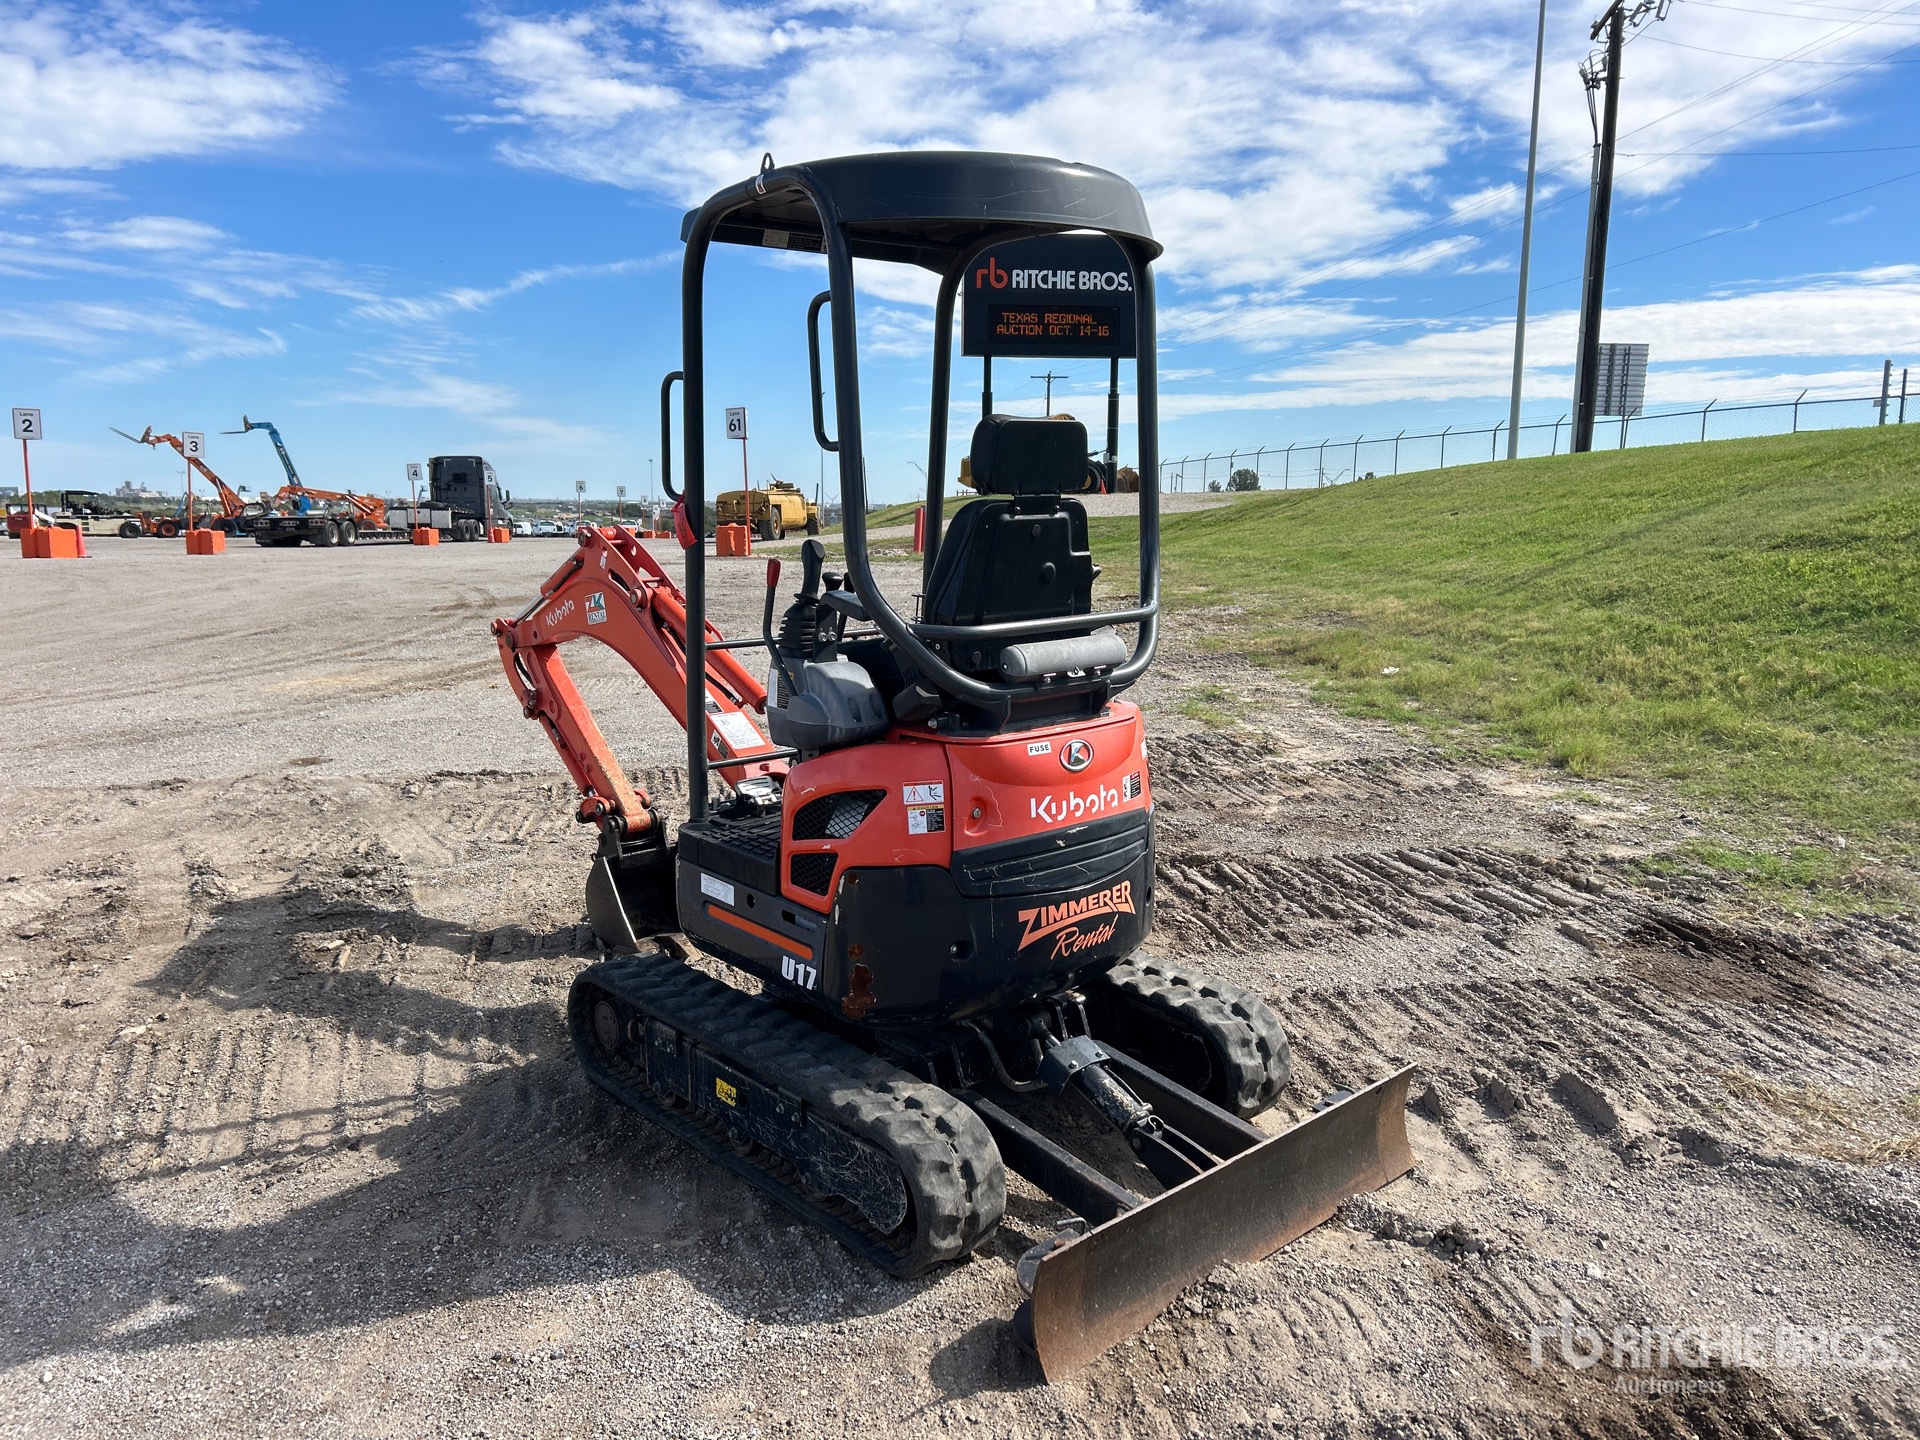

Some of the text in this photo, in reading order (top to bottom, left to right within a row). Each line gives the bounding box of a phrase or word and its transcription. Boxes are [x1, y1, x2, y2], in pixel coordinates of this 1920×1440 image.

[976, 257, 1133, 292] rb RITCHIE BROS.
[1002, 312, 1097, 325] TEXAS REGIONAL
[997, 324, 1110, 337] AUCTION OCT. 14-16
[21, 418, 34, 433] 2
[728, 418, 741, 432] 61
[189, 440, 199, 453] 3
[412, 469, 418, 477] 4
[545, 599, 575, 627] Kubota
[1029, 743, 1050, 754] FUSE
[1030, 784, 1119, 824] Kubota
[1018, 880, 1136, 951] ZIMMERER
[1050, 913, 1119, 960] Rental
[781, 955, 817, 991] U17
